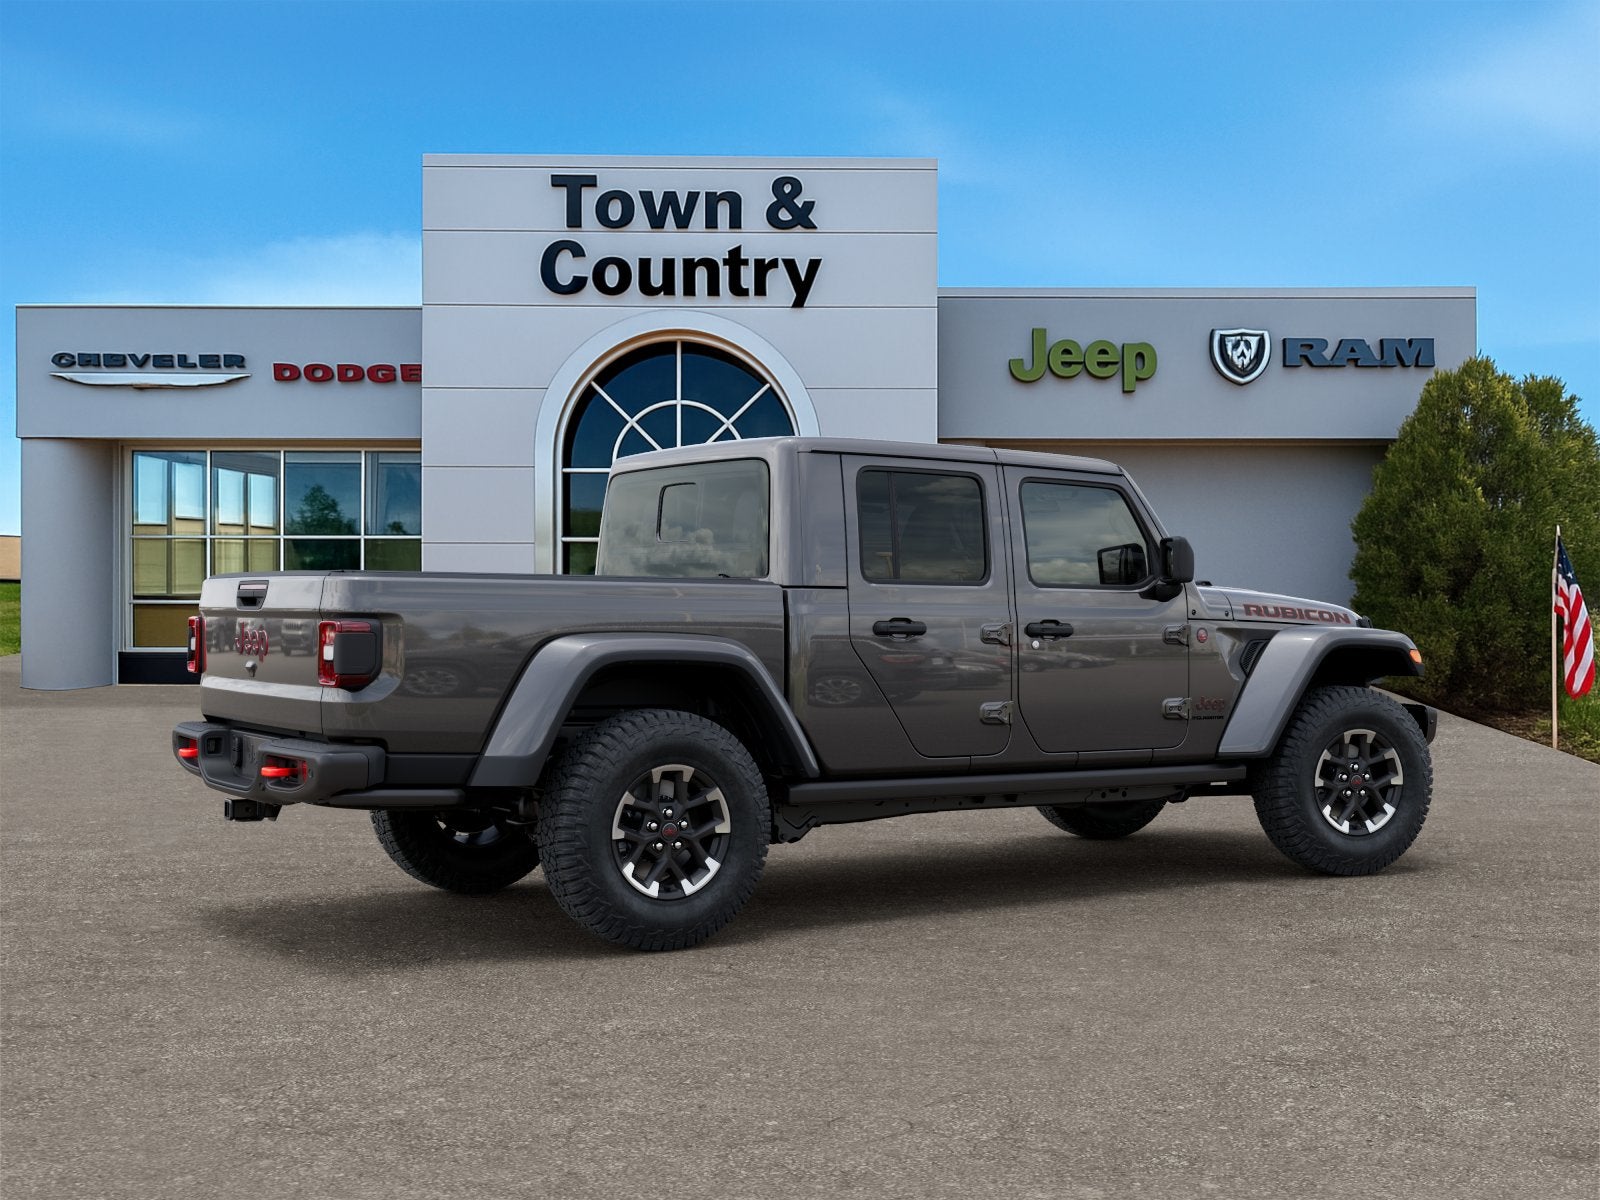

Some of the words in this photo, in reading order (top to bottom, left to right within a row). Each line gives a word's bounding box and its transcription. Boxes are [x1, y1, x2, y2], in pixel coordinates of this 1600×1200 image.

[550, 174, 742, 229] Town
[765, 176, 818, 230] &
[540, 239, 822, 308] Country
[273, 362, 422, 383] DODGE
[1009, 327, 1157, 393] Jeep
[1282, 337, 1435, 368] RAM
[1243, 604, 1351, 624] RUBICON
[234, 621, 269, 663] Jeep
